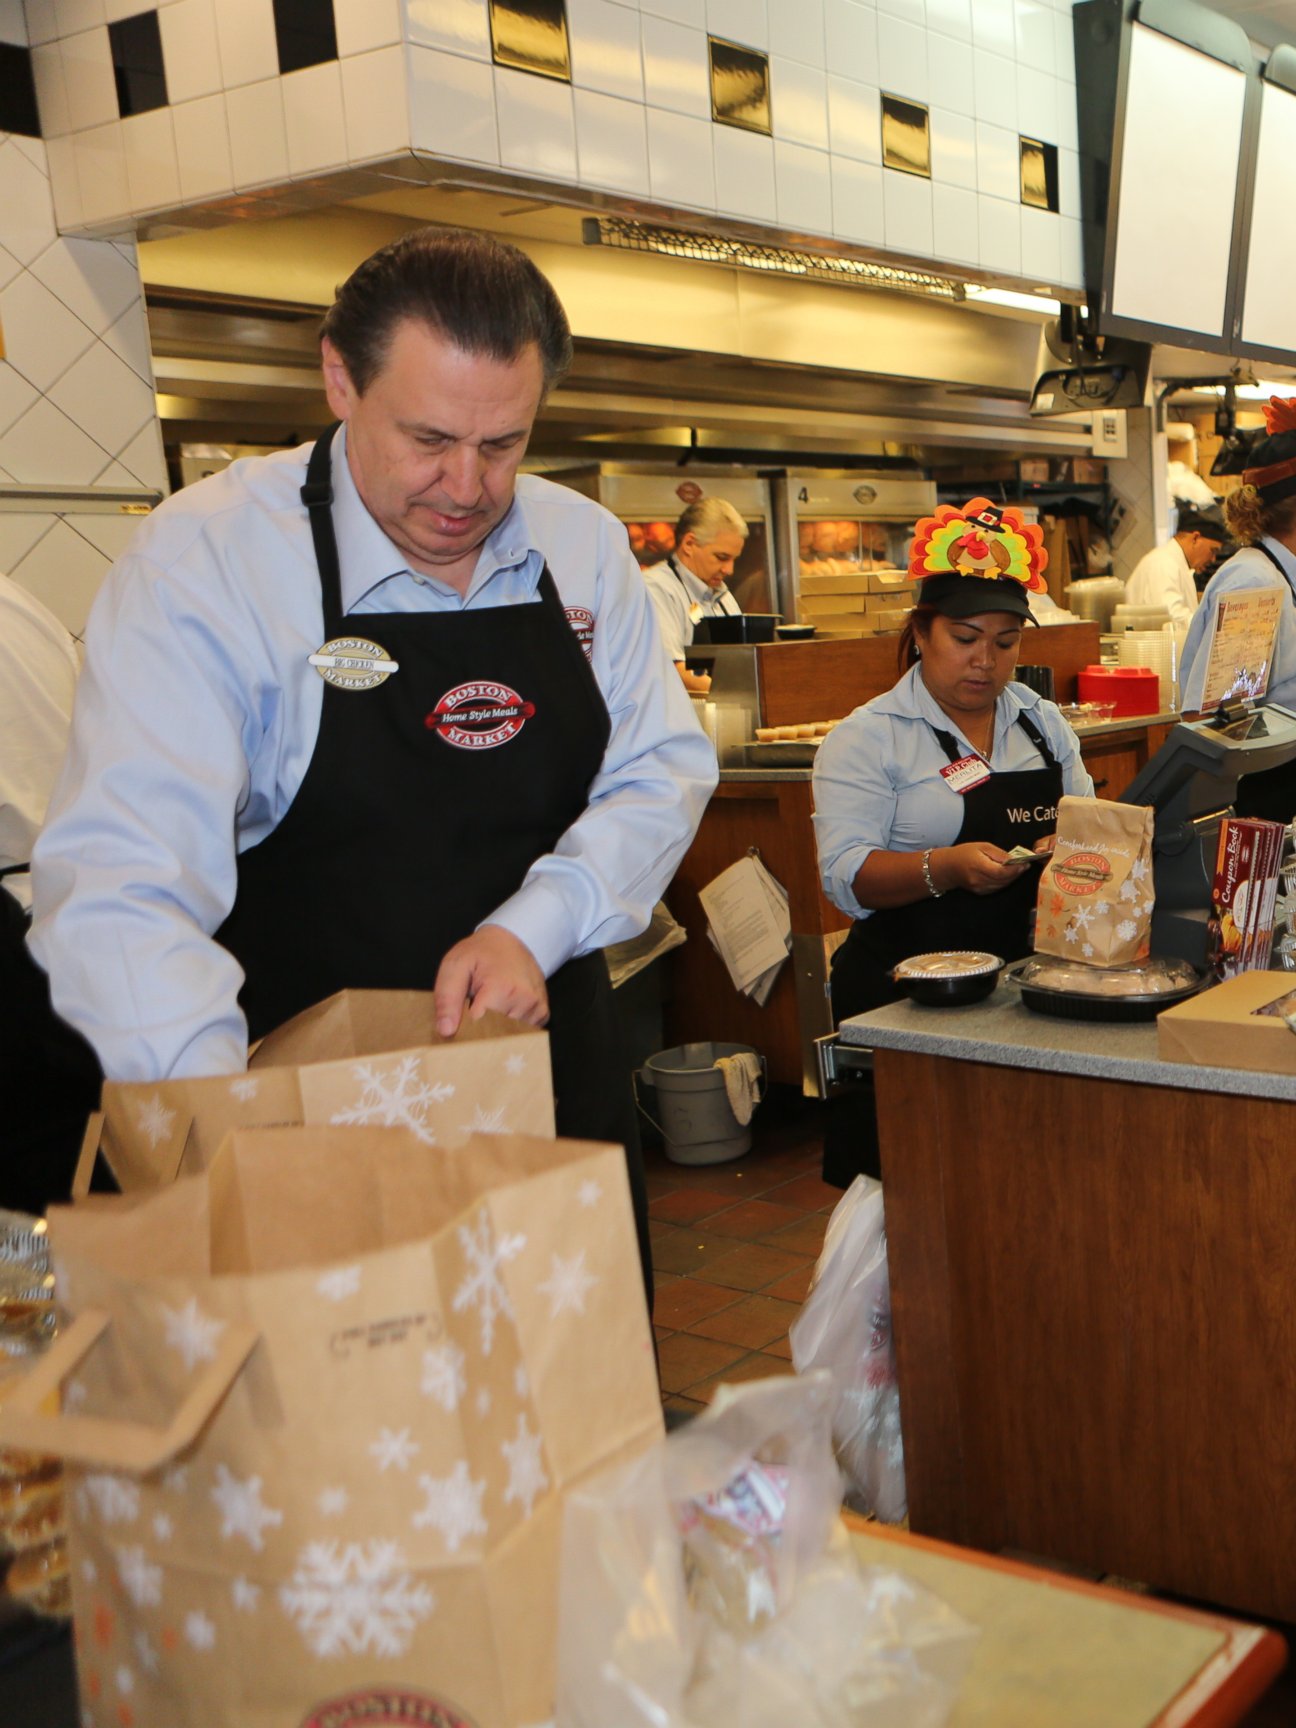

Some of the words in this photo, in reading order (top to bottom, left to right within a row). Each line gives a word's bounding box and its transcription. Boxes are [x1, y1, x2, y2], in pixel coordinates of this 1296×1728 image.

[326, 639, 384, 658] BOSTON
[324, 668, 382, 688] MARKET
[444, 684, 513, 708] BOSTON
[442, 713, 468, 723] Home
[468, 709, 491, 722] Style
[491, 706, 519, 718] Meals
[448, 721, 517, 747] MARKET
[1006, 807, 1031, 823] We
[1226, 826, 1240, 854] Book
[1221, 853, 1237, 904] Coupon
